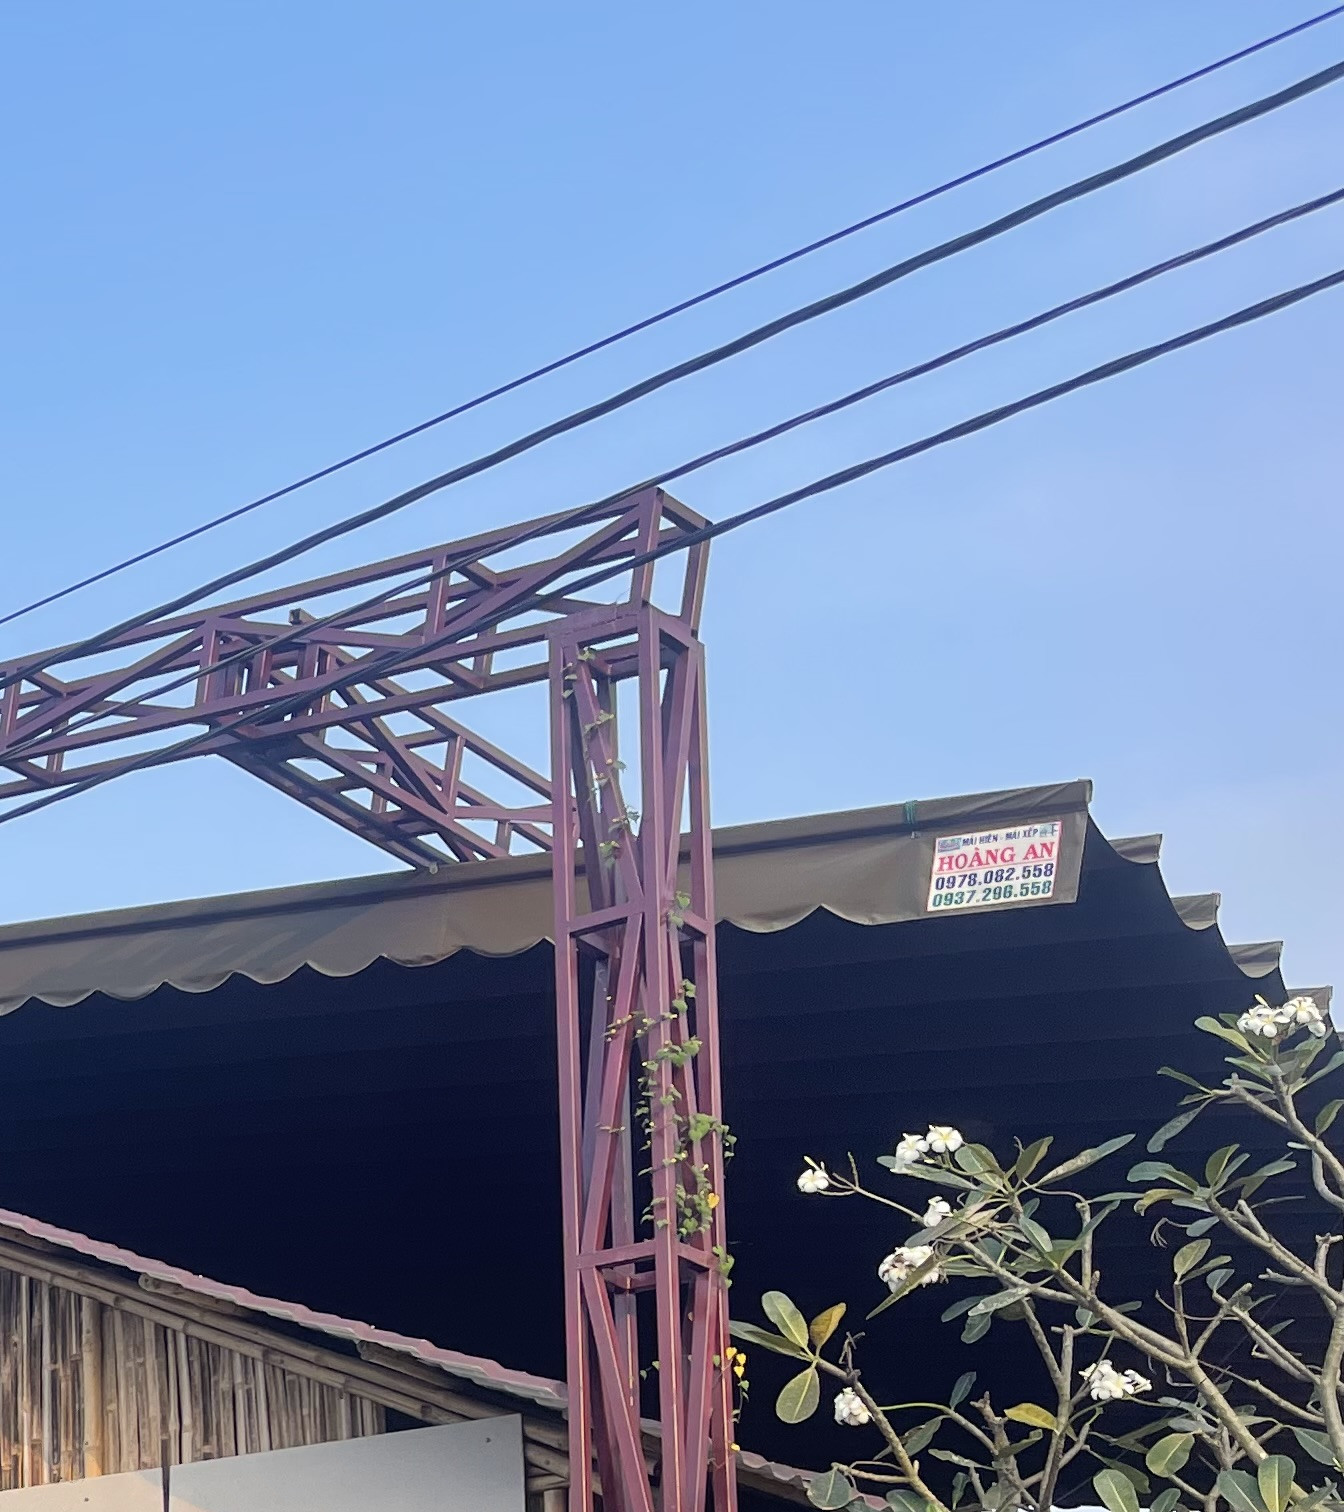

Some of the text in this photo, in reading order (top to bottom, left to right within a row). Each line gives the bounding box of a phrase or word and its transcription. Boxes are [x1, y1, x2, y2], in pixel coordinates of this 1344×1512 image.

[937, 842, 1055, 872] HOÀNG AN
[935, 863, 1055, 890] 0978.082.558
